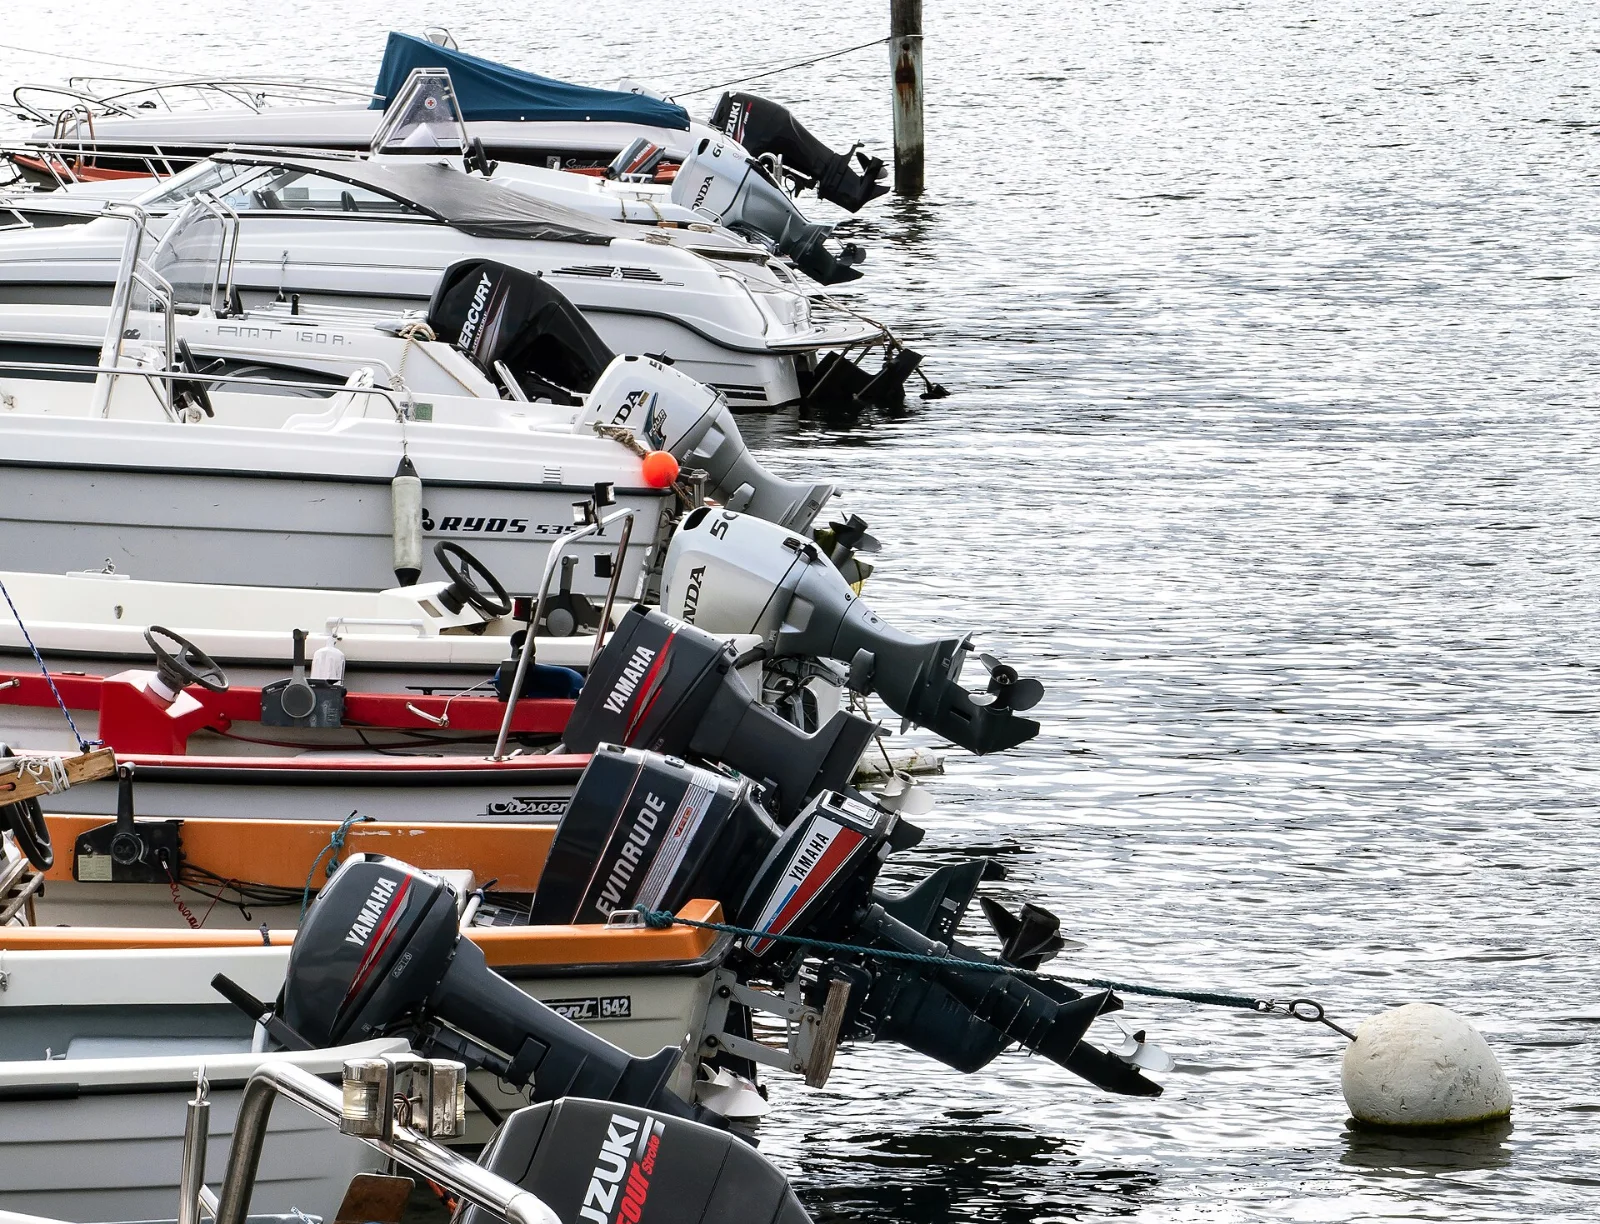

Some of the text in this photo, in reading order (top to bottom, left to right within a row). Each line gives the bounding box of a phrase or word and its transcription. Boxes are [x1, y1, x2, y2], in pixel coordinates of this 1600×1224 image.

[217, 326, 281, 340] AMT
[457, 272, 492, 349] ERCURY
[682, 565, 706, 625] NDA
[603, 646, 656, 714] YAMAHA
[595, 792, 666, 918] EVINRUDE
[788, 832, 830, 882] YAMAHA
[345, 877, 398, 946] YAMAHA
[602, 998, 629, 1016] 542
